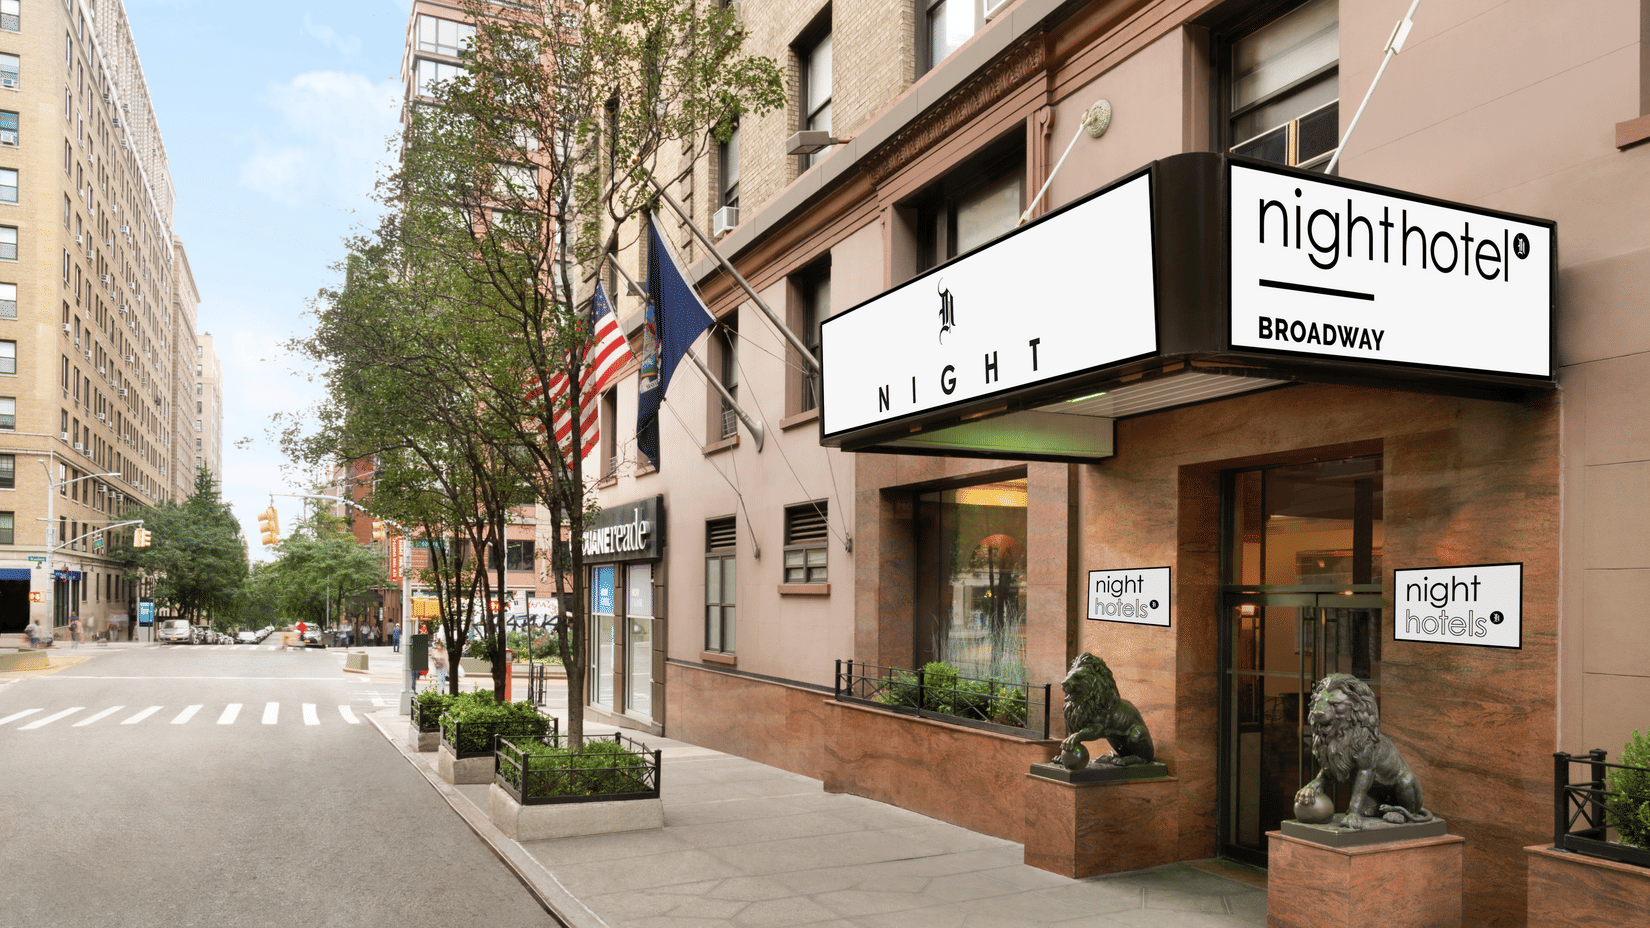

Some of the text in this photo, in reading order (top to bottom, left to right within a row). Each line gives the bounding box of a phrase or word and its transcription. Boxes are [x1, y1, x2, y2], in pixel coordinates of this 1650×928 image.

[1259, 187, 1509, 282] nighthotel
[1259, 315, 1385, 351] BROADWAY
[878, 337, 1041, 413] NIGHT
[1096, 574, 1144, 597] night
[1406, 575, 1481, 608] night
[1094, 597, 1149, 619] hotels
[1405, 608, 1488, 638] hotels
